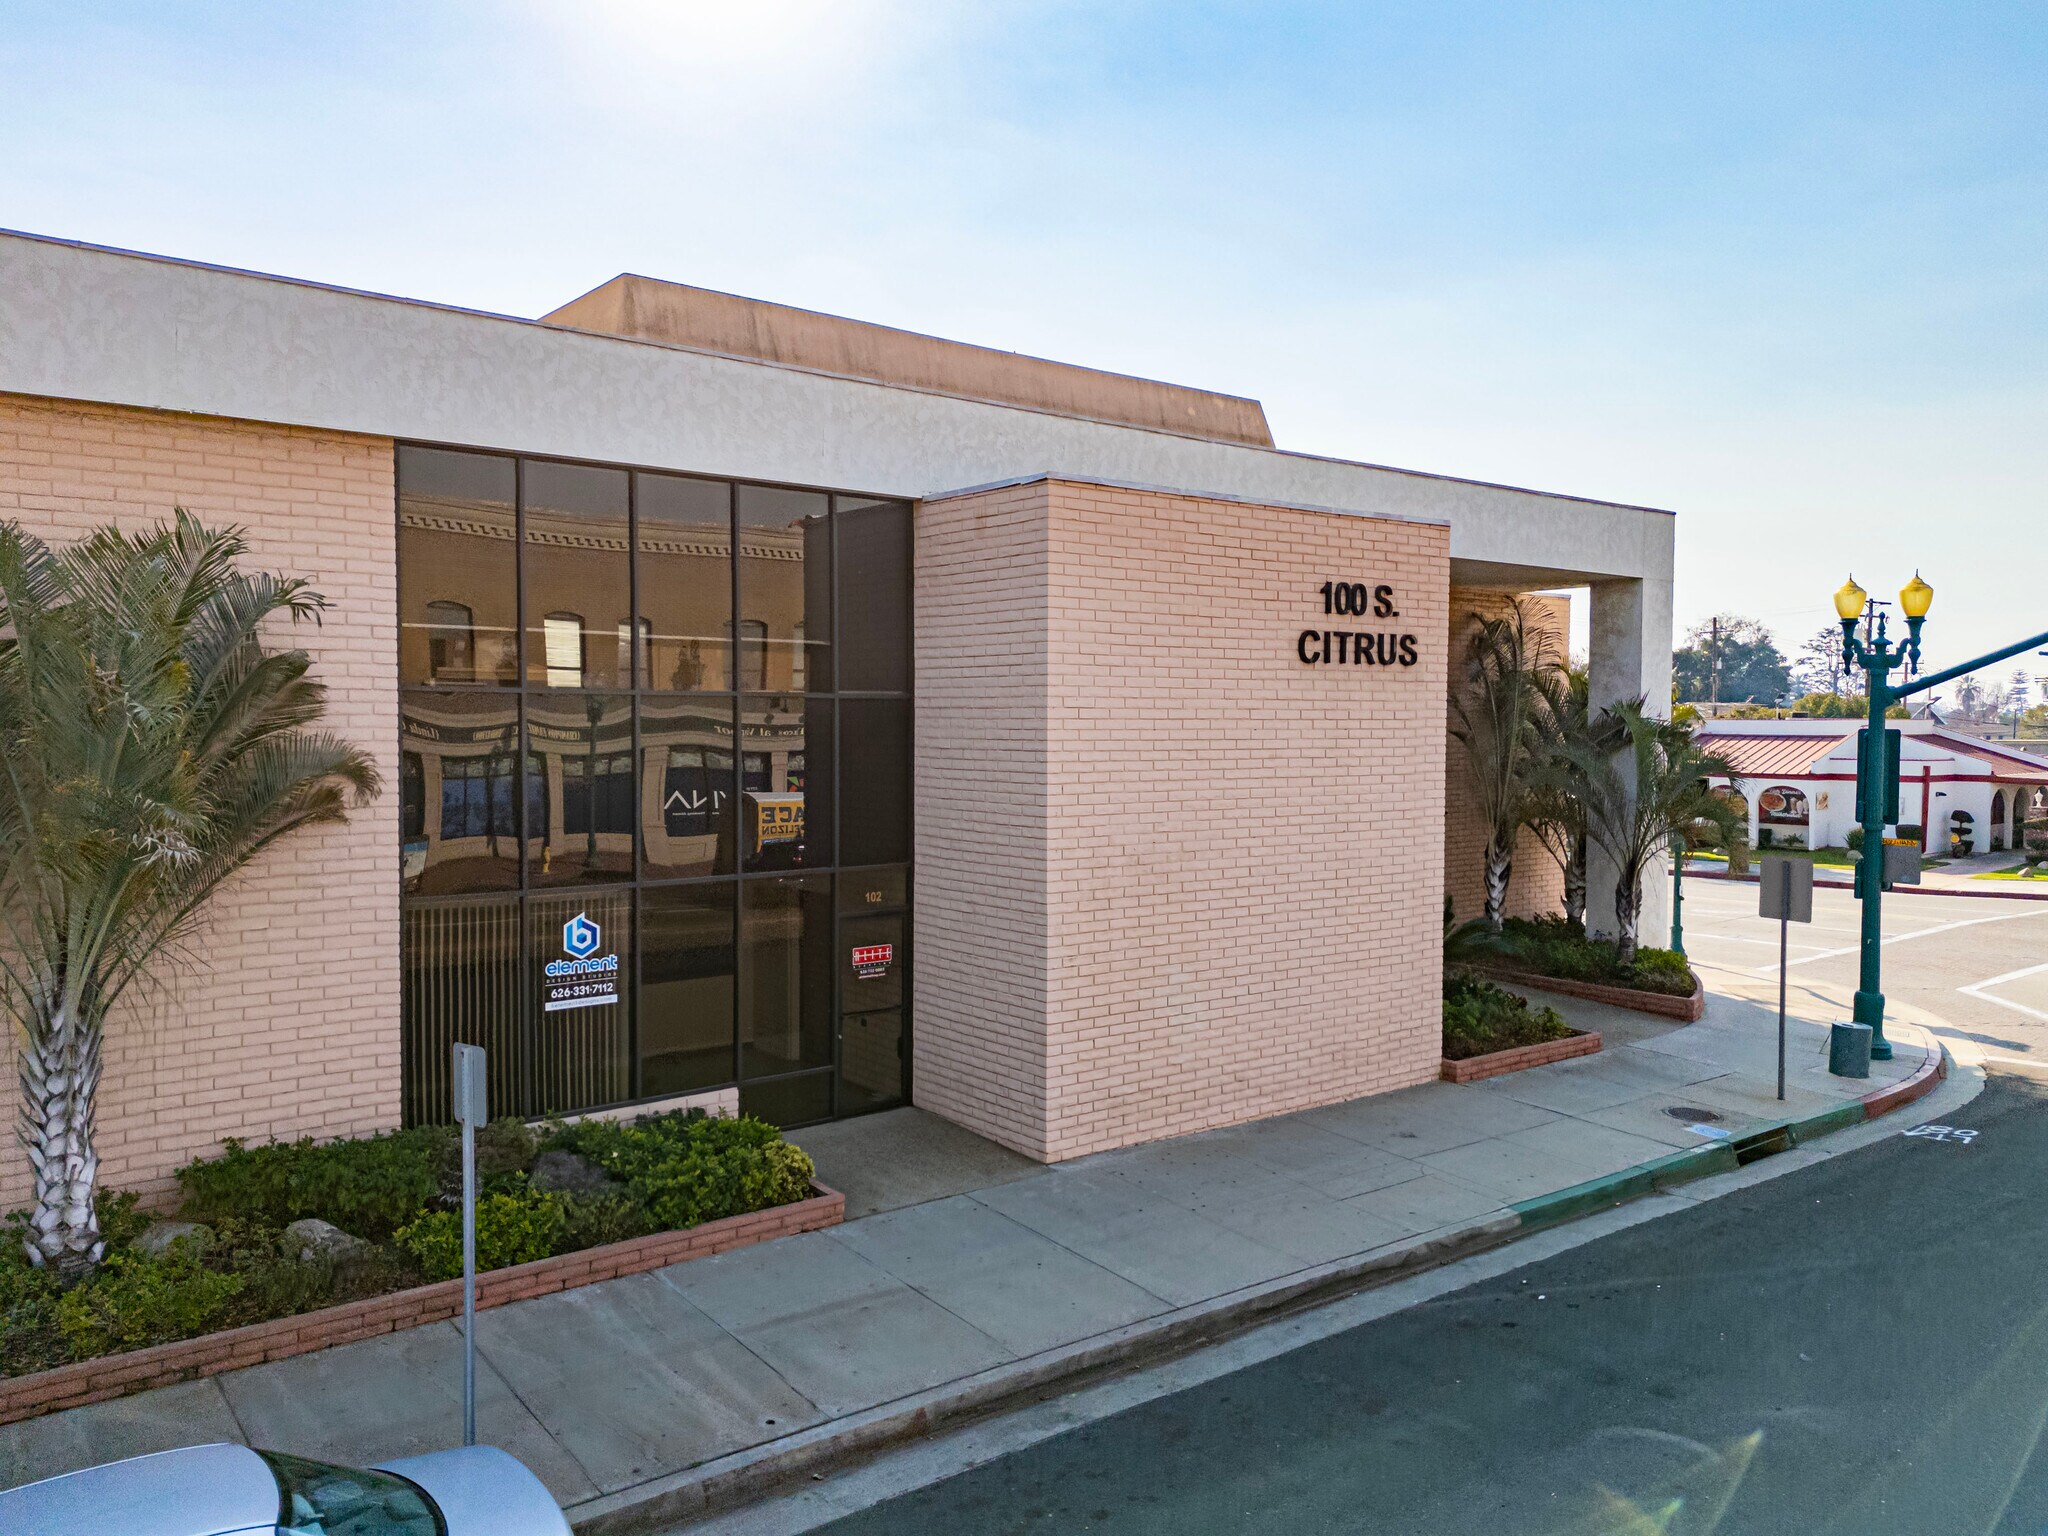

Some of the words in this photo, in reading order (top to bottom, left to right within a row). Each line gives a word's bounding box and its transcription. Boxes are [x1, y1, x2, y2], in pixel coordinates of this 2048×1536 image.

[1320, 581, 1368, 616] 100
[1374, 585, 1399, 618] S.
[1298, 630, 1418, 666] CITRUS
[865, 891, 882, 902] 102
[545, 954, 618, 976] element
[546, 976, 577, 984] DESIGN
